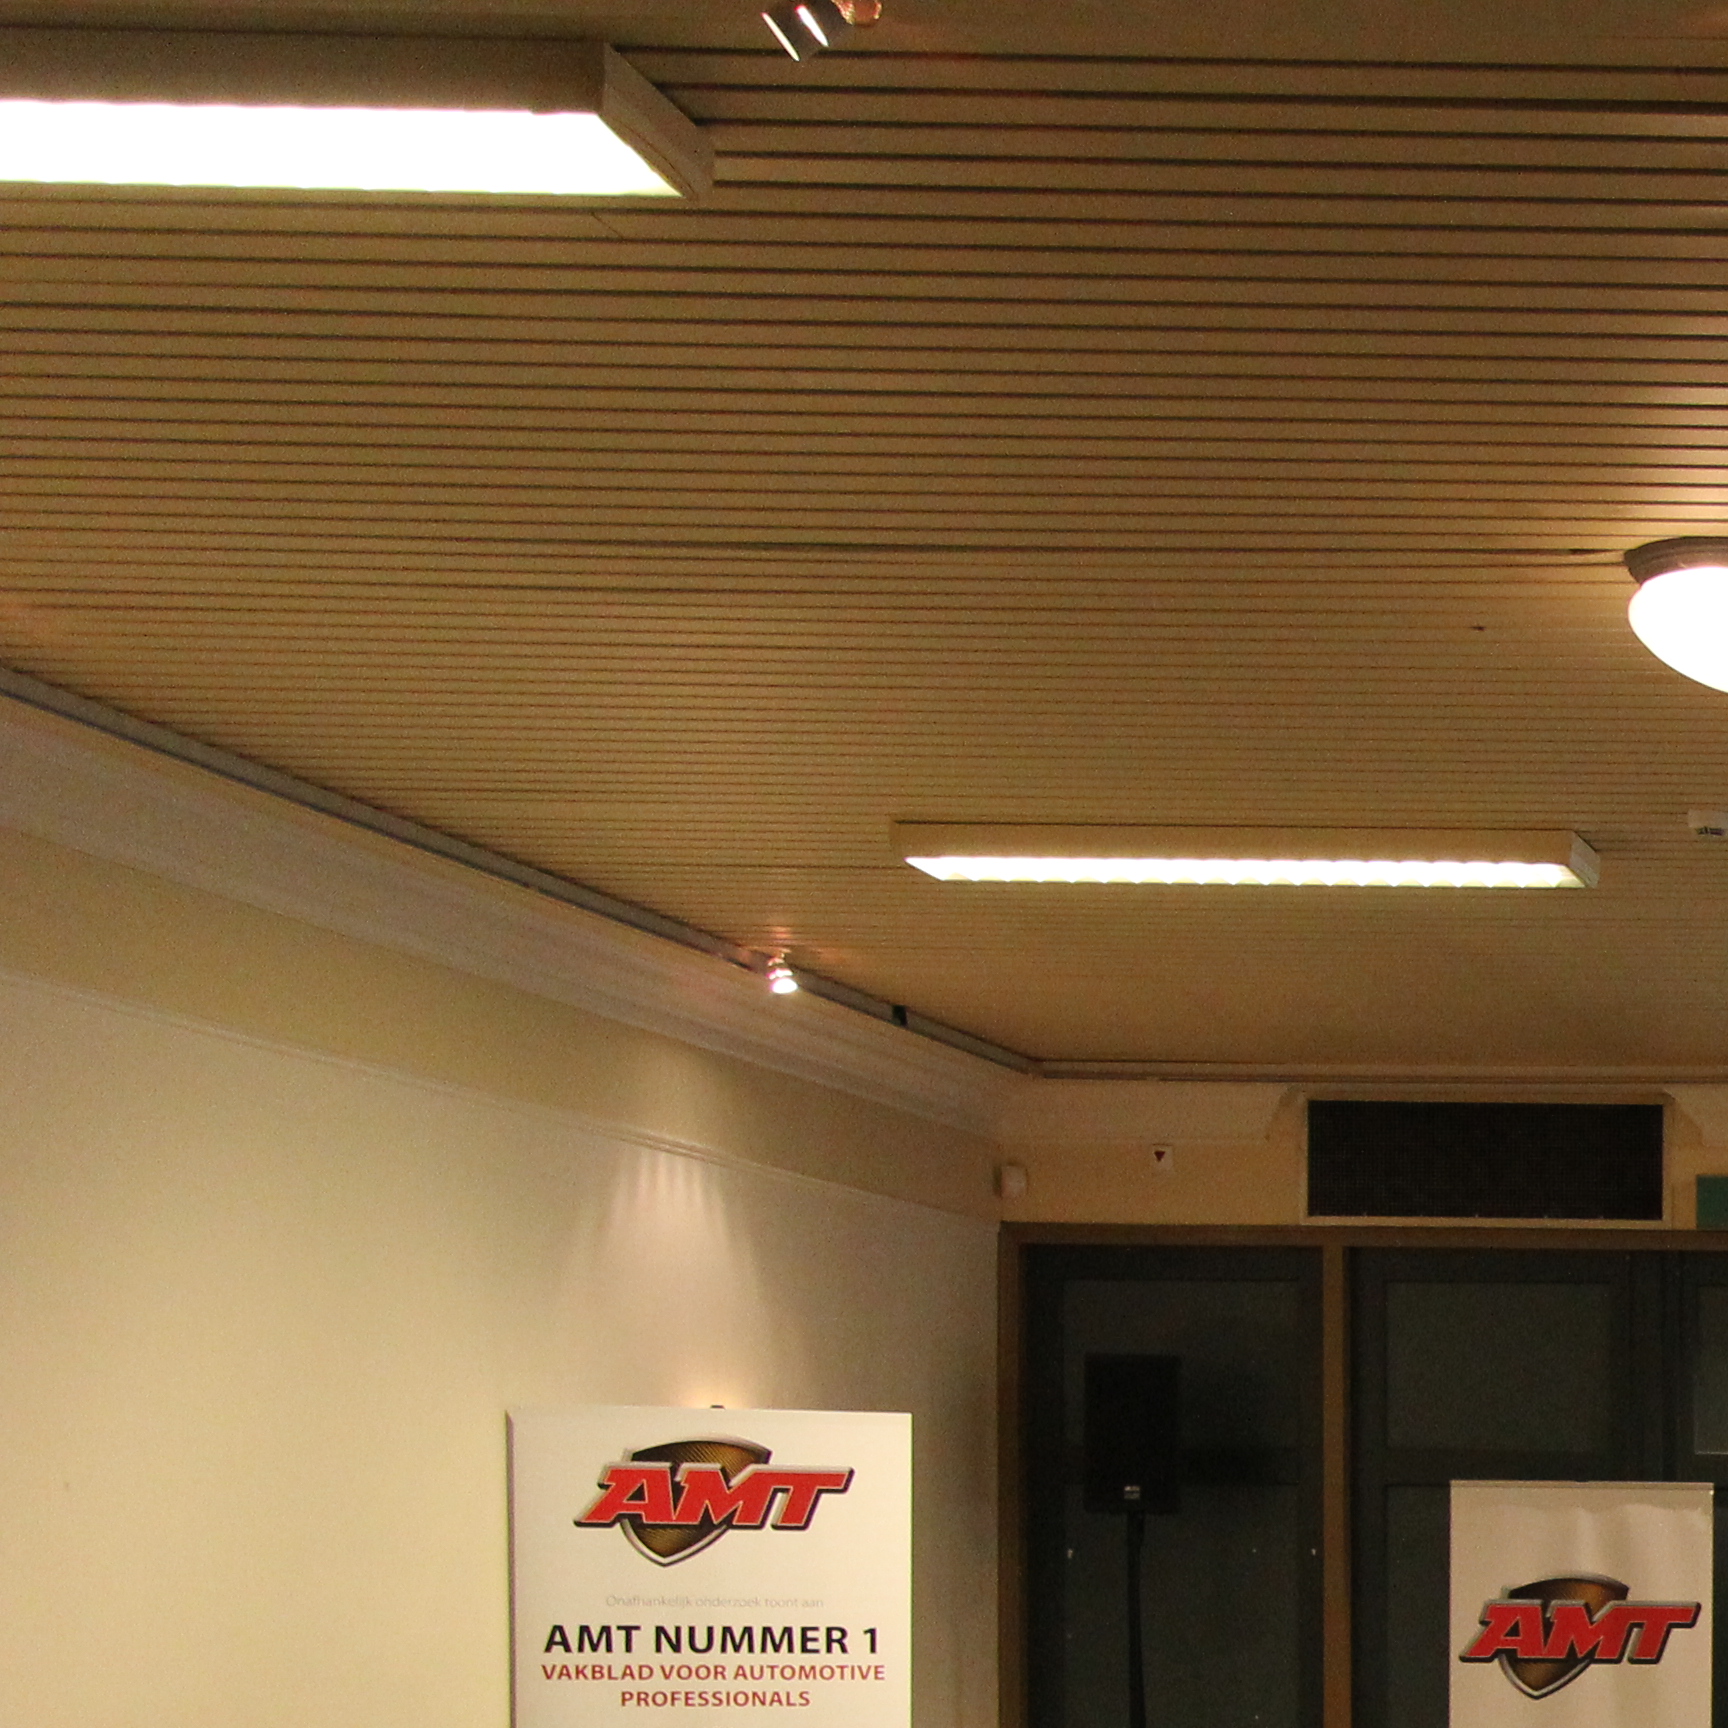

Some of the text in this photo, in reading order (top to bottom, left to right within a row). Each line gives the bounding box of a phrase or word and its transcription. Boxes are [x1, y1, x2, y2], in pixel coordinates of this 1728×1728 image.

[573, 1461, 855, 1531] AMT
[543, 1624, 877, 1655] AMT NUMMER 1
[1458, 1599, 1702, 1664] AMT
[540, 1663, 885, 1681] VAKBLAD VOOR AUTOMOTIVE
[620, 1690, 810, 1708] PROFESSIONALS
